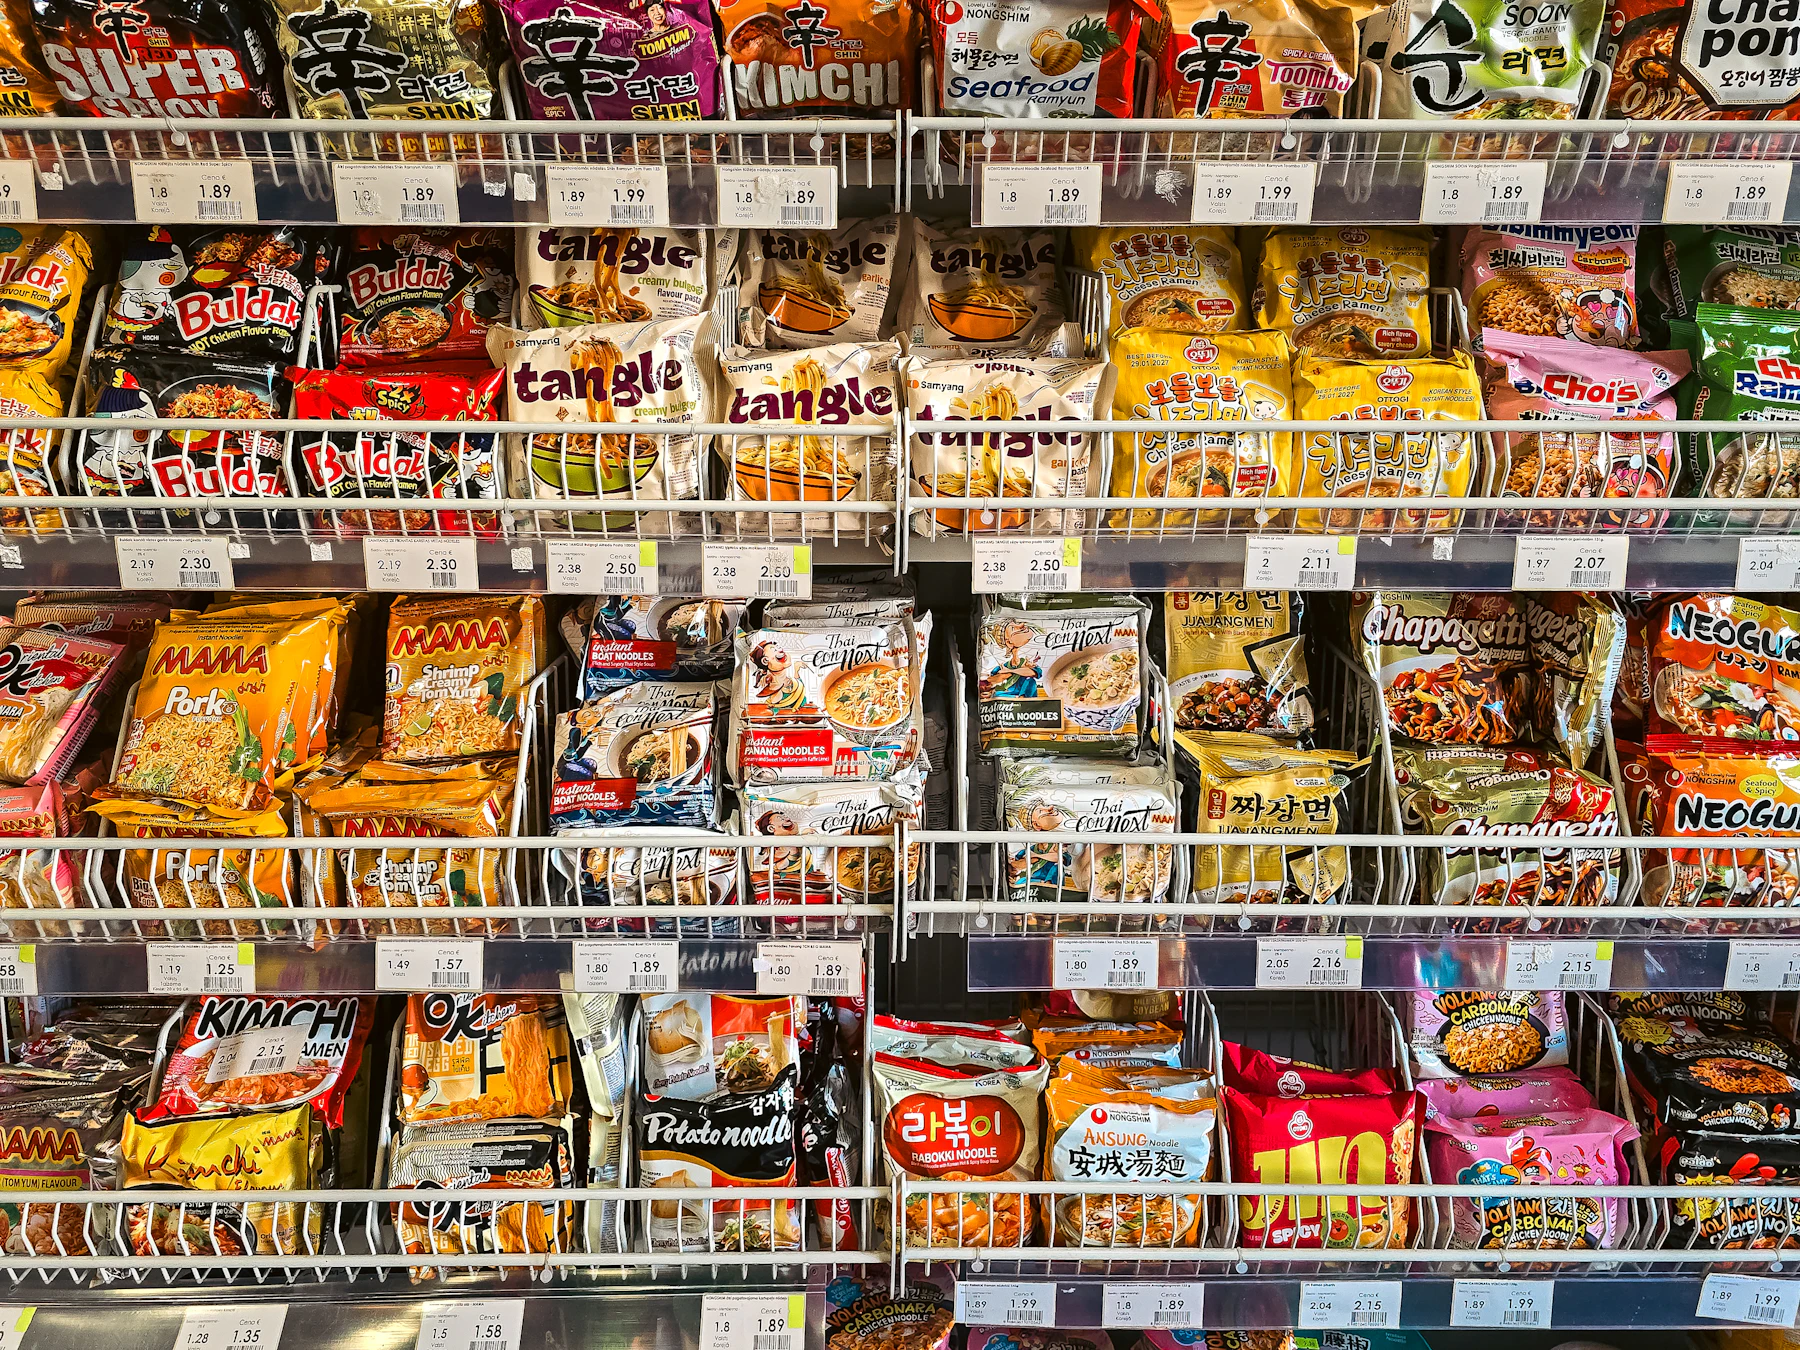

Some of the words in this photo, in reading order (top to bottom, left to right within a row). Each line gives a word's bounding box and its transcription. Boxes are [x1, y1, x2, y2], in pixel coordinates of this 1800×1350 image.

[966, 9, 1030, 22] NONGSHIM
[1503, 3, 1572, 25] SOON
[148, 37, 169, 46] SHIN
[955, 31, 979, 45] 모듬
[138, 47, 177, 63] RED
[834, 51, 860, 59] SHIN
[41, 42, 246, 103] SUPER
[1266, 59, 1350, 91] Toomba
[1719, 69, 1765, 88] 오징어
[397, 70, 471, 102] 라면
[625, 72, 699, 103] 라면
[736, 59, 899, 109] KIMCHI
[947, 72, 1095, 98] Seafood
[1027, 93, 1086, 105] Ramyun
[1221, 94, 1248, 103] SHIN
[408, 102, 478, 120] SHIN
[631, 100, 700, 120] SHIN
[149, 186, 168, 198] 1.8
[199, 184, 231, 199] 1.89
[560, 191, 585, 202] 1.89
[613, 188, 645, 203] 1.99
[1000, 191, 1017, 203] 1.8
[1048, 188, 1080, 202] 1.89
[1207, 187, 1232, 199] 1.89
[1260, 186, 1292, 200] 1.99
[1442, 189, 1459, 200] 1.8
[1491, 185, 1523, 200] 1.89
[1735, 186, 1766, 200] 1.89
[537, 227, 700, 274] tangle
[762, 230, 887, 272] tangle
[1109, 233, 1194, 259] 보들보들
[1489, 250, 1567, 269] 최씨비빔면
[1102, 254, 1198, 287] 치즈라면
[349, 257, 454, 308] Buldak
[637, 275, 670, 288] creamy
[671, 276, 704, 296] bulgogi
[1117, 278, 1159, 301] Cheese
[1159, 275, 1199, 287] Ramen
[175, 286, 303, 340] Buldak
[515, 336, 560, 349] Samyang
[727, 362, 772, 374] Samyang
[1131, 359, 1169, 367] 29.01.2027
[514, 351, 685, 406] tangle
[921, 380, 964, 393] Samyang
[1149, 372, 1241, 404] 보들보들
[1543, 374, 1642, 404] Choi's
[377, 391, 409, 411] Spicy
[130, 559, 154, 569] 2.19
[179, 557, 211, 570] 2.30
[426, 558, 457, 570] 2.30
[558, 564, 582, 574] 2.38
[606, 562, 637, 575] 2.50
[982, 562, 1006, 572] 2.38
[1030, 559, 1060, 572] 2.50
[1301, 556, 1330, 569] 2.11
[1527, 559, 1550, 568] 1.97
[1573, 556, 1606, 569] 2.07
[713, 567, 737, 577] 2.38
[1182, 616, 1273, 629] JJAJANGMEN
[1362, 605, 1526, 652] Chapagetti
[392, 618, 508, 656] MAMA
[826, 634, 856, 648] Thai
[151, 645, 269, 674] MAMA
[592, 653, 613, 661] BOAT
[616, 652, 653, 660] NOODLES
[1717, 652, 1766, 672] 너구리
[422, 664, 479, 681] Shrimp
[424, 677, 474, 689] Creamy
[165, 687, 225, 716] Pork
[1014, 712, 1057, 720] NOODLES
[744, 746, 779, 756] PANANG
[782, 746, 824, 755] NOODLES
[1686, 774, 1736, 785] NONGSHIM
[1745, 779, 1778, 788] Seafood
[554, 794, 573, 804] BOAT
[574, 792, 616, 802] NOODLES
[1754, 787, 1777, 796] Spicy
[206, 963, 235, 975] 1.25
[388, 960, 410, 969] 1.49
[435, 958, 463, 970] 1.57
[632, 961, 660, 973] 1.89
[1111, 958, 1139, 970] 1.89
[1264, 958, 1290, 969] 2.05
[1312, 957, 1341, 968] 2.16
[1561, 961, 1592, 972] 2.15
[159, 965, 181, 974] 1.19
[815, 964, 842, 976] 1.89
[1451, 1004, 1528, 1024] CARBONARA
[256, 1044, 285, 1057] 2.15
[903, 1100, 1001, 1146] 라볶이
[1109, 1114, 1151, 1124] NONGSHIM
[644, 1114, 721, 1144] Potato
[1084, 1127, 1146, 1147] ANSUNG
[1149, 1139, 1179, 1148] Noodle
[912, 1150, 954, 1161] RABOKKI
[957, 1148, 996, 1157] NOODLE
[144, 1146, 261, 1180] Kimchi
[41, 1178, 76, 1187] FLAVOUR
[1010, 1298, 1037, 1309] 1.99
[1158, 1299, 1185, 1310] 1.89
[1354, 1300, 1382, 1311] 2.15
[1508, 1298, 1534, 1309] 1.99
[1755, 1293, 1781, 1306] 1.99
[475, 1324, 502, 1339] 1.58
[715, 1321, 730, 1333] 1.8
[757, 1318, 785, 1333] 1.89
[187, 1333, 209, 1344] 1.28
[233, 1329, 261, 1343] 1.35
